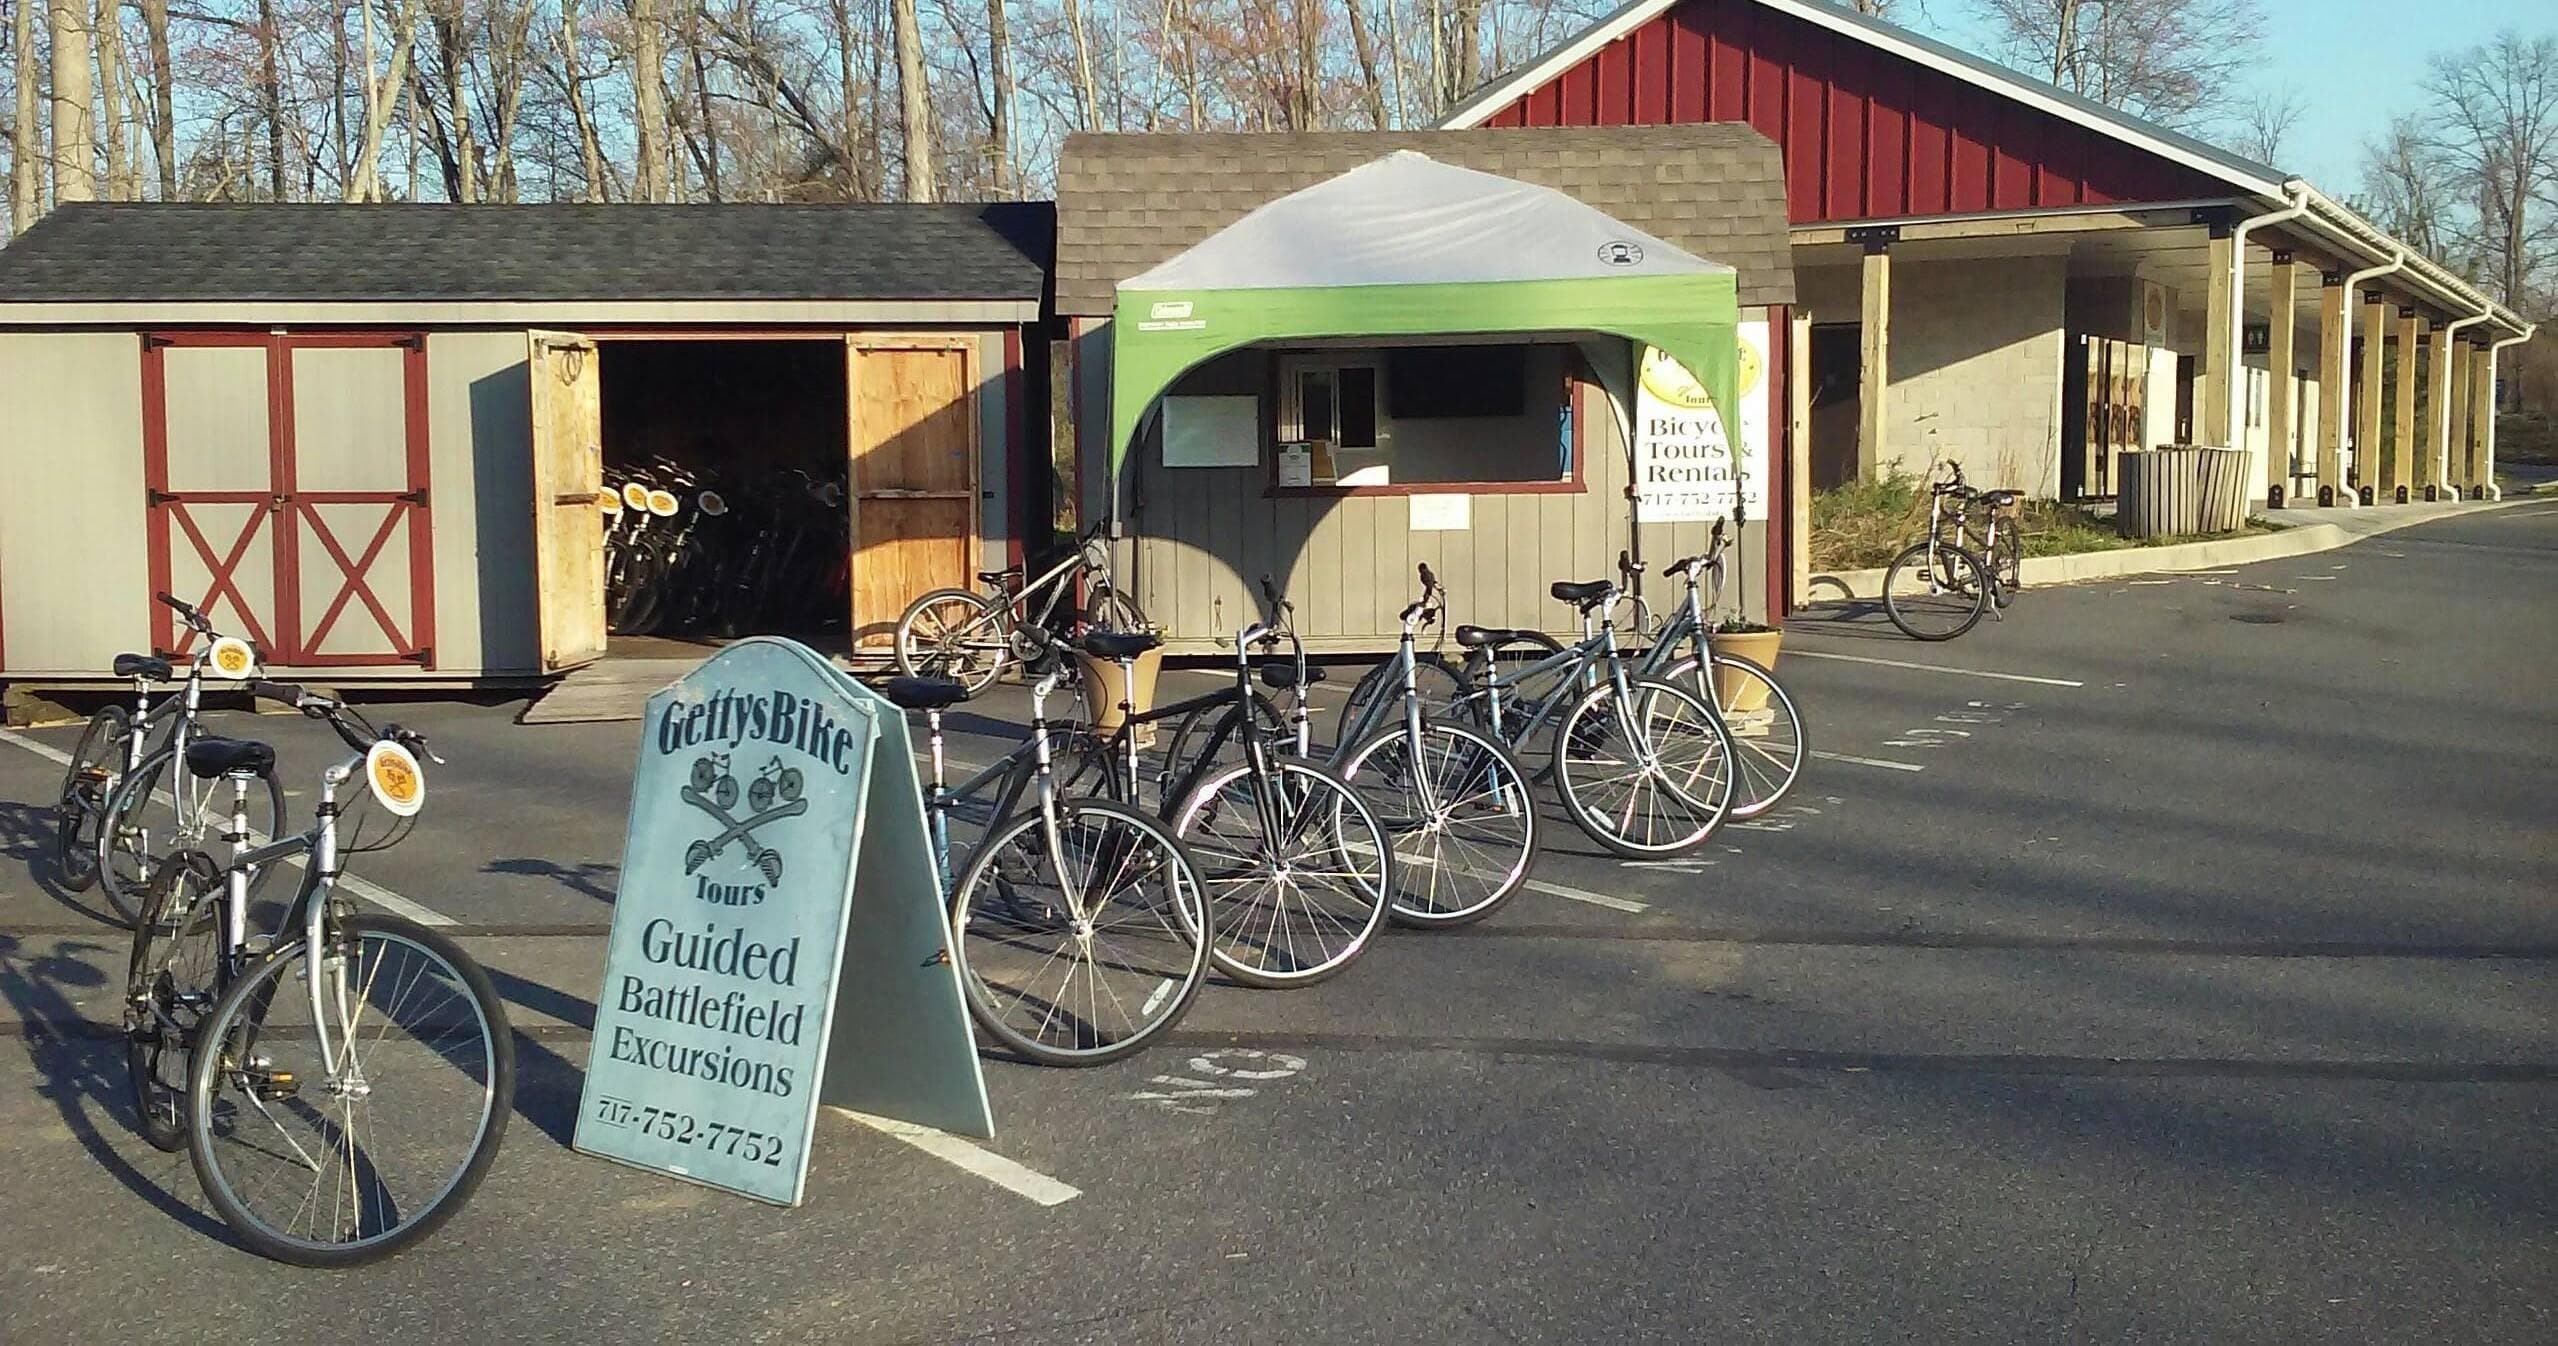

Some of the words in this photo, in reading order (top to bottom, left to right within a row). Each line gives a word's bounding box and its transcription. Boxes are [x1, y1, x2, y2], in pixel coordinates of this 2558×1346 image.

[1645, 442, 1725, 460] Tours
[1650, 417, 1749, 440] Bicyc
[1648, 464, 1750, 482] Rentals
[658, 687, 854, 776] GettysBike
[695, 873, 766, 906] Tours
[642, 918, 801, 986] Guided
[618, 975, 805, 1046] Battlefield
[609, 1025, 795, 1098] Excursions
